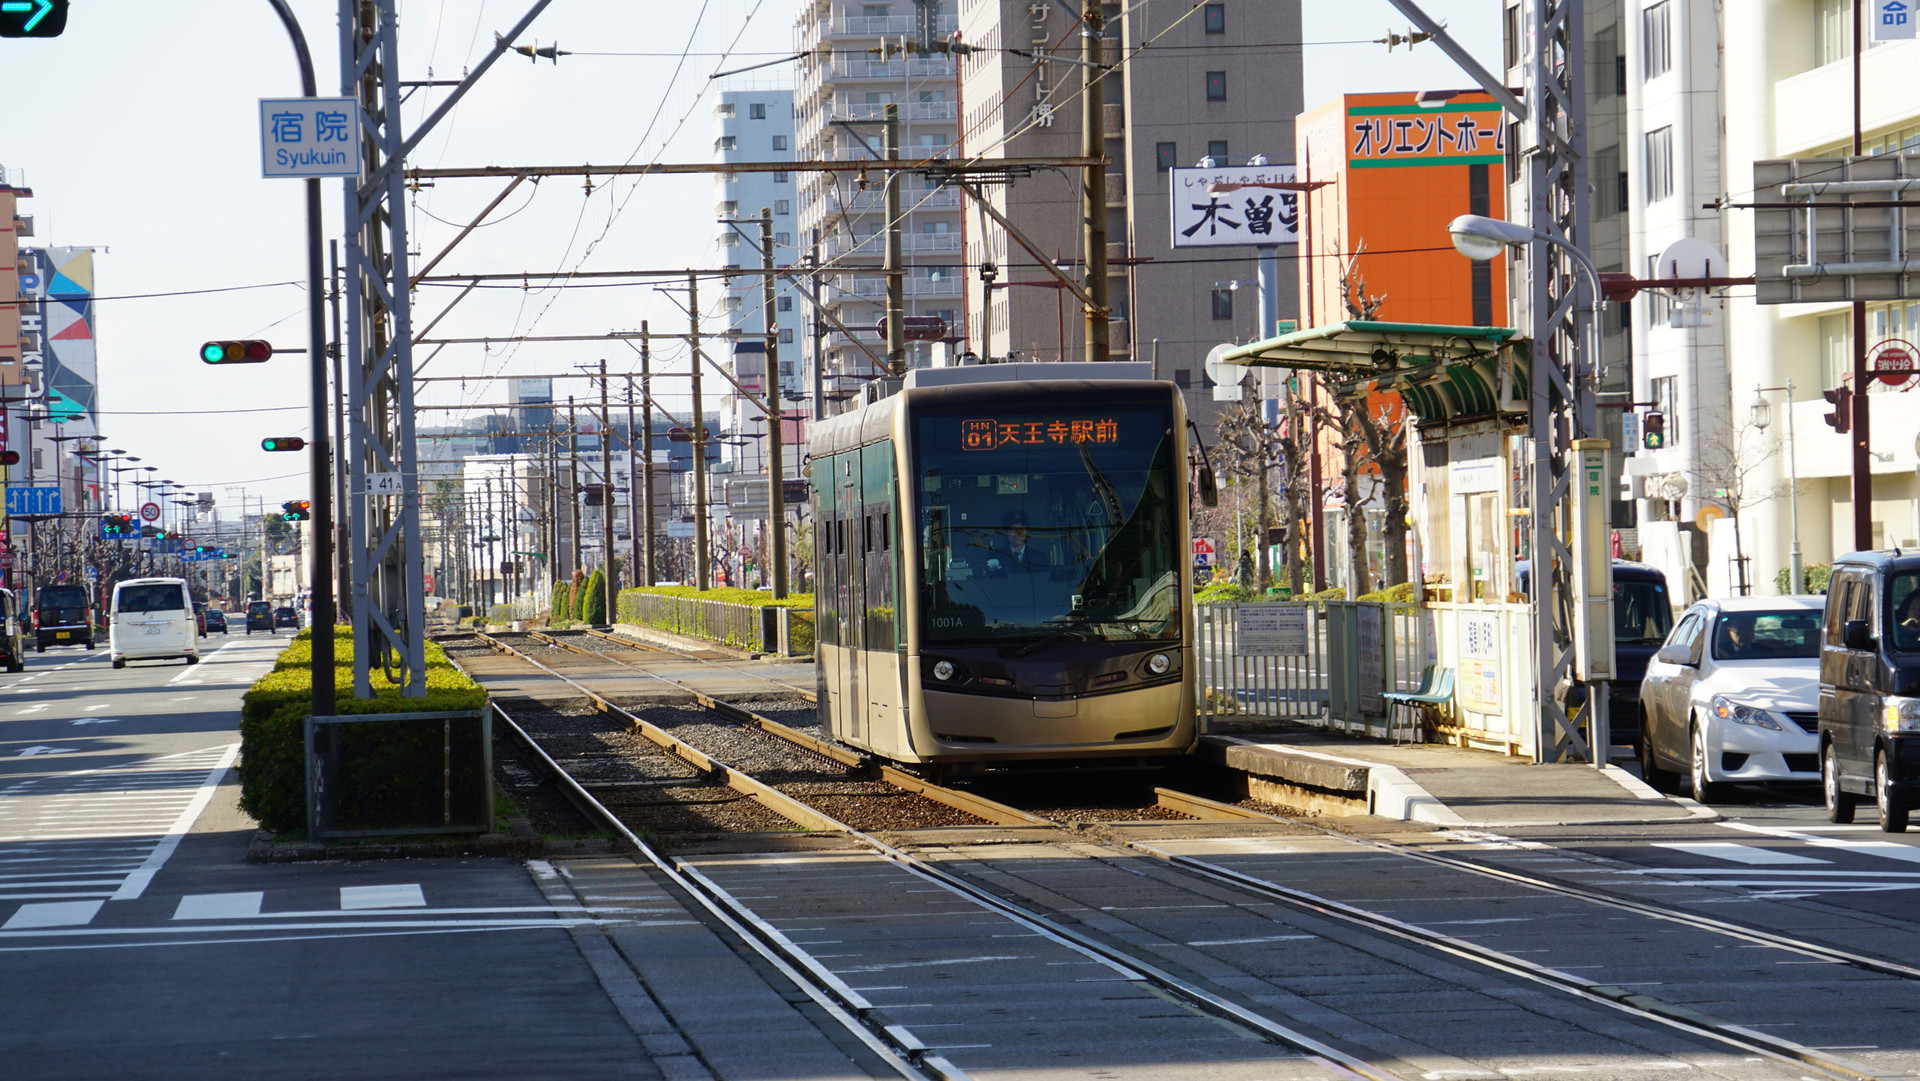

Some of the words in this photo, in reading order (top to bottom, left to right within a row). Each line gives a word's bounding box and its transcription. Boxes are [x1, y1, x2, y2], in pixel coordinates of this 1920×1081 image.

[270, 110, 349, 143] 宿院
[276, 147, 346, 169] Syukuin
[1878, 359, 1911, 371] 消火栓
[970, 422, 990, 431] HN
[999, 418, 1118, 445] 天王寺駅前
[967, 432, 992, 447] 01
[379, 477, 393, 491] 41
[1588, 471, 1600, 496] 宿院
[144, 507, 156, 517] 50
[931, 617, 963, 628] 1001A
